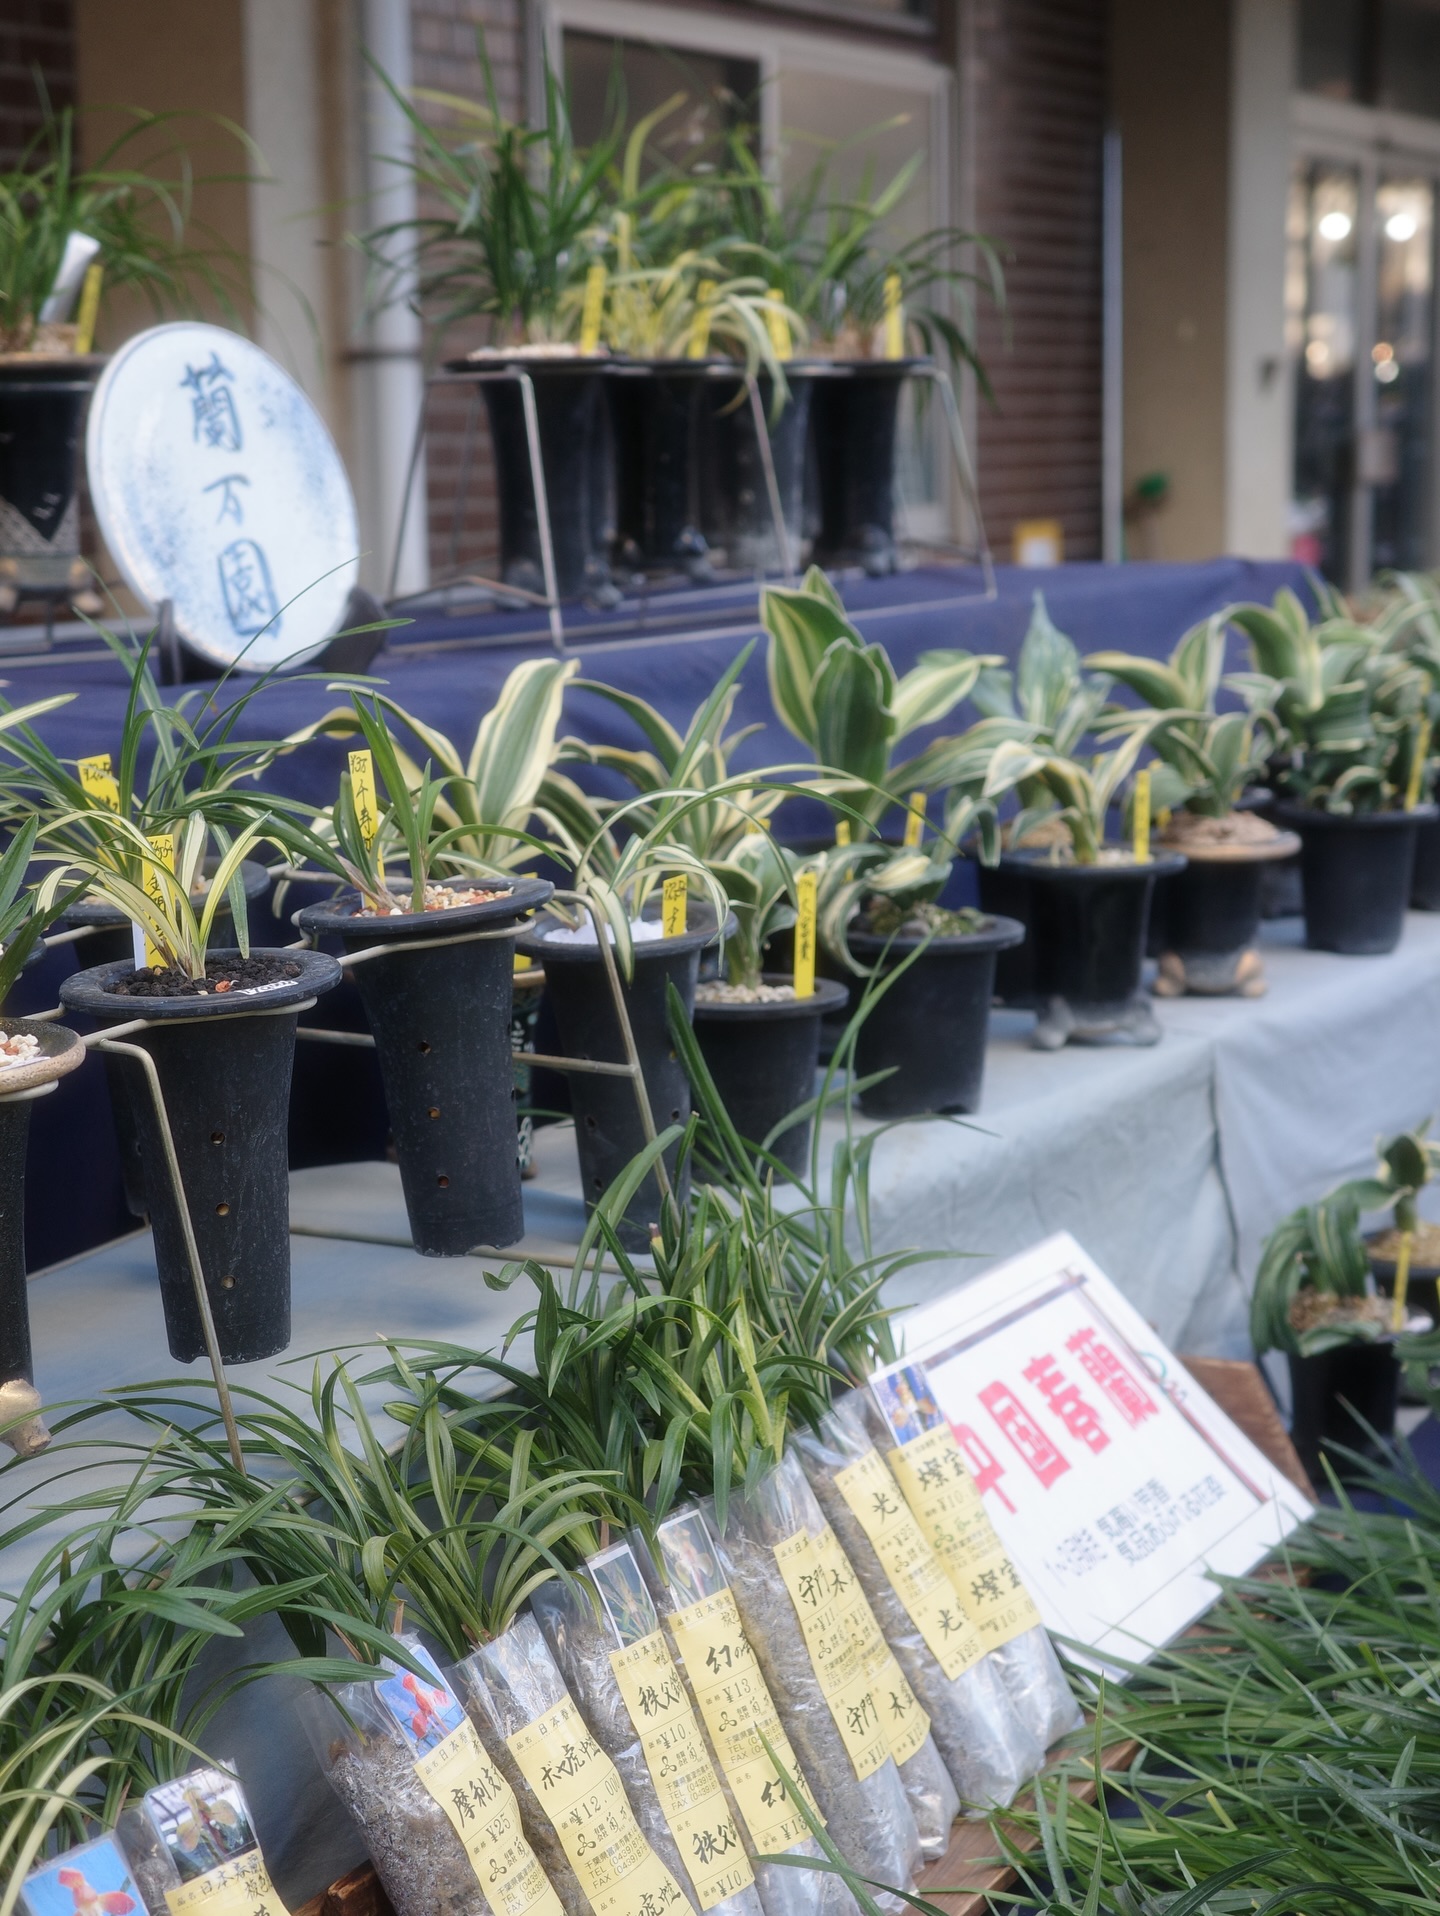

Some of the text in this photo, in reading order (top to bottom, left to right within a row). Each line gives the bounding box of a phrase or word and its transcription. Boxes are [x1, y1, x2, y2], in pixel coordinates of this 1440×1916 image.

[727, 1743, 745, 1755] TEL
[730, 1751, 749, 1764] FAX
[668, 1789, 686, 1801] TEL
[671, 1796, 689, 1810] FAX
[588, 1865, 608, 1880] TEL
[592, 1873, 612, 1889] FAX
[501, 1892, 518, 1905] TEL
[506, 1900, 523, 1916] FAX
